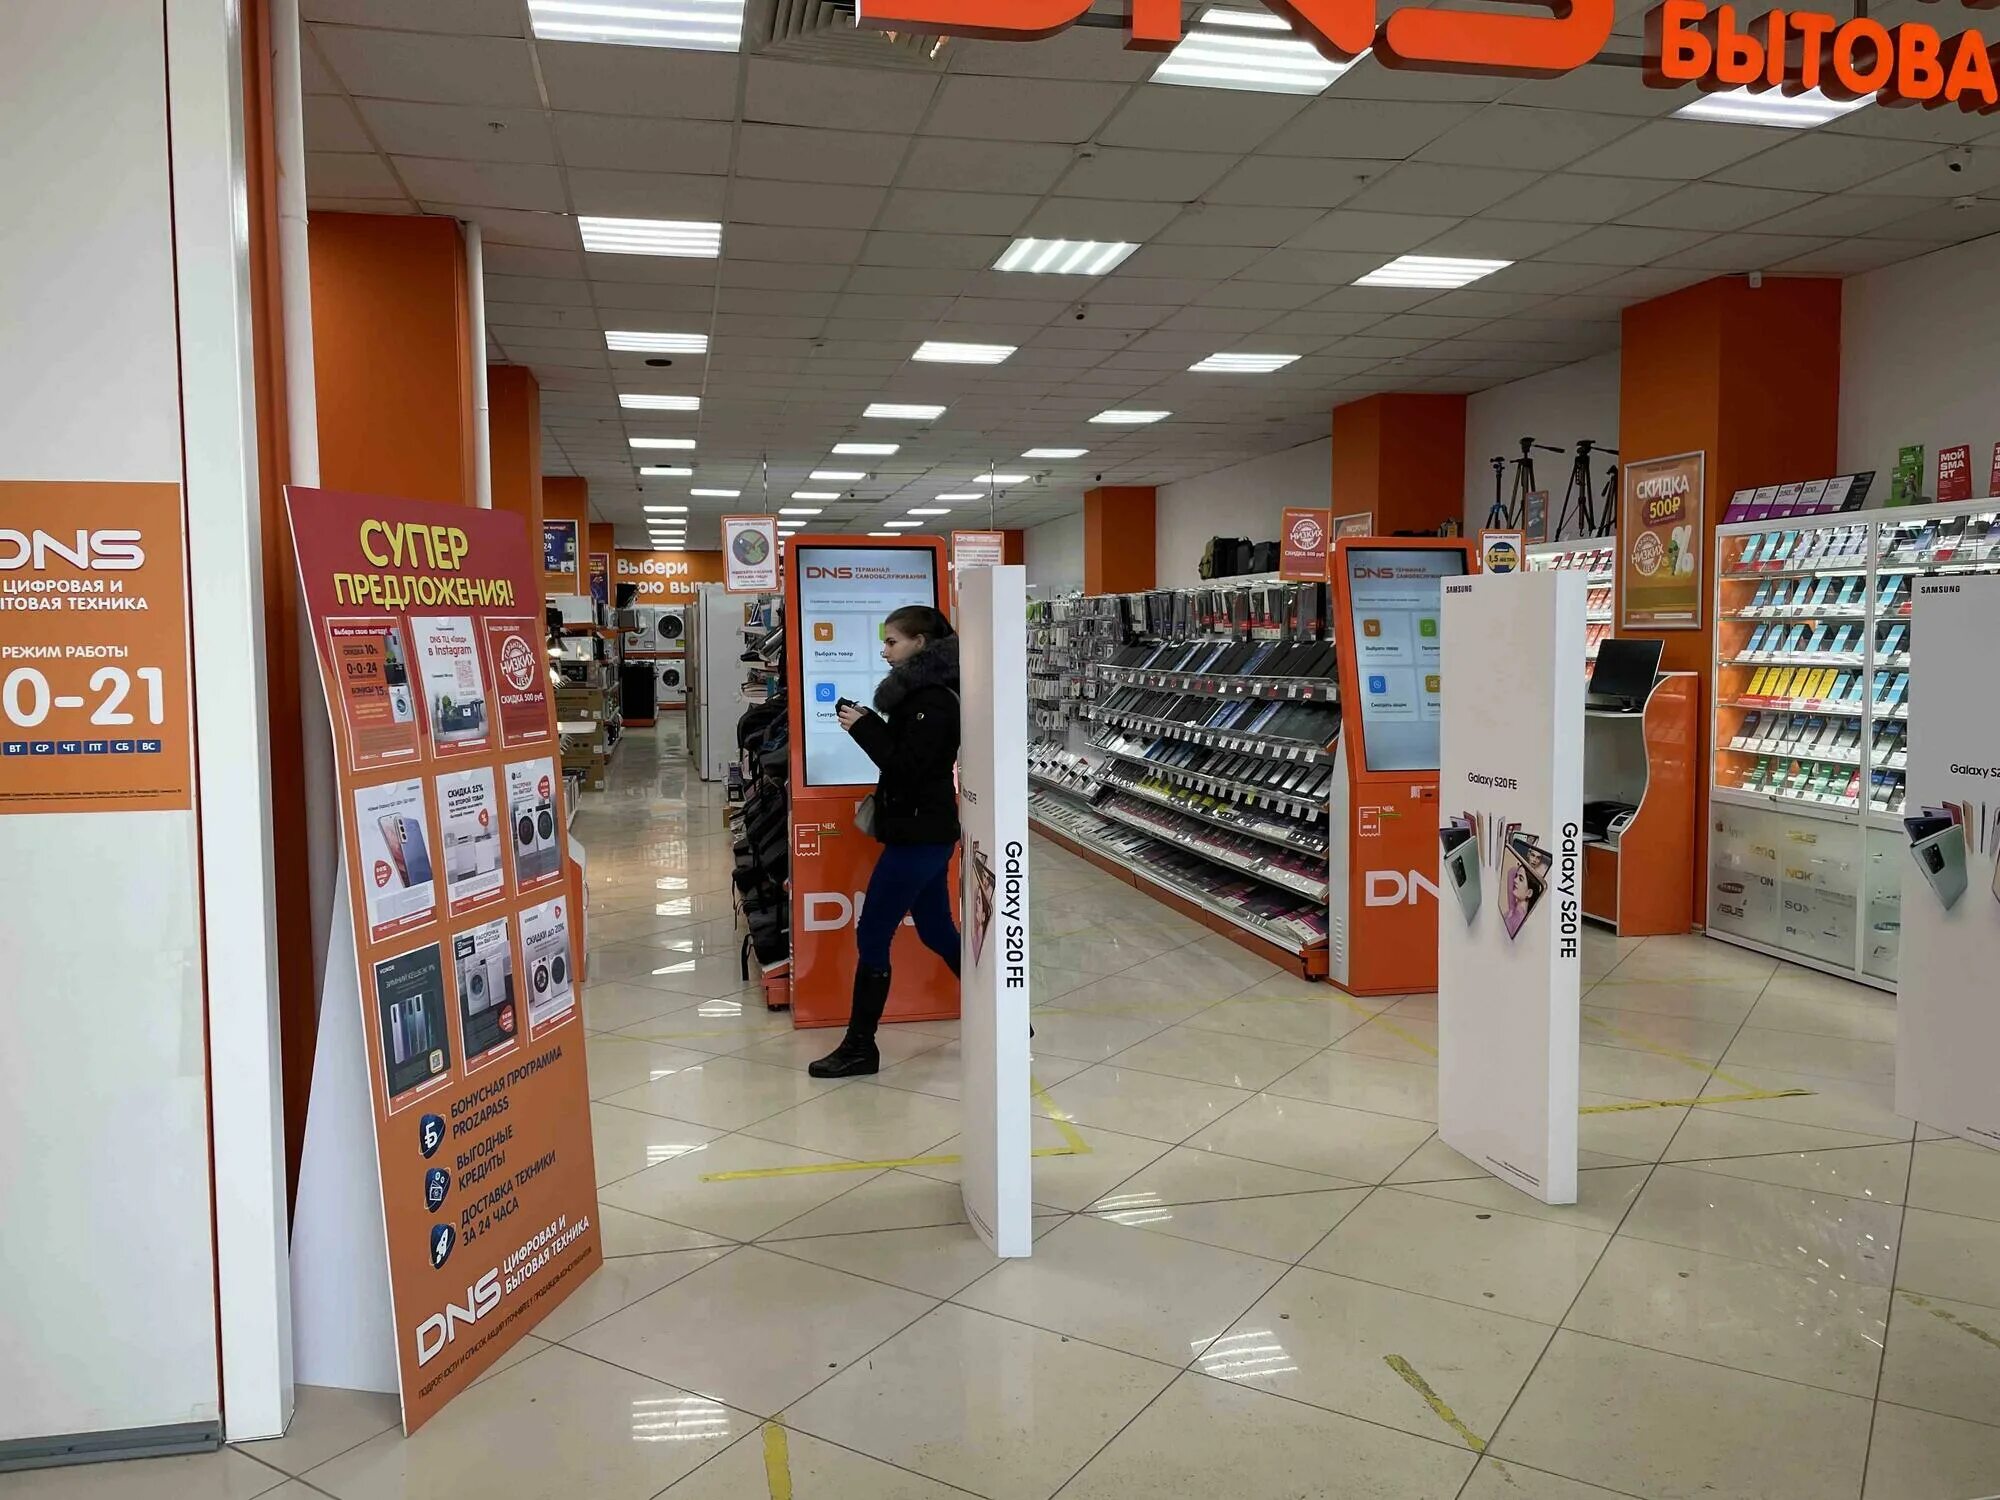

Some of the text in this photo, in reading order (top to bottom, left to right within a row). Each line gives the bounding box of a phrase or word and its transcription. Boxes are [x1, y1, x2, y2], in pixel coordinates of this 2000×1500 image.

[1660, 0, 1999, 105] БЫТОВА
[1940, 448, 1965, 462] МОЙ
[1636, 475, 1690, 499] СКИДКА
[1289, 529, 1323, 540] НИЗКИХ
[360, 519, 469, 570] СУПЕР
[1631, 543, 1665, 564] НИЗКИХ
[1489, 554, 1499, 563] 1,5
[617, 559, 688, 578] Выбери
[806, 566, 853, 579] DNS
[1353, 567, 1394, 579] DNS
[3, 580, 123, 594] ЦИФРОВАЯ И
[333, 573, 515, 611] ПРЕДЛОЖЕНИЯ!
[1446, 585, 1472, 594] SAMSUNG
[1920, 585, 1961, 594] SAMSUNG
[0, 597, 149, 611] ТОВАЯ ТЕХНИКА
[2, 647, 128, 658] РЕЖИМ РАБОТЫ
[435, 645, 472, 658] Instagram
[500, 652, 536, 676] НИЗКИХ
[501, 695, 524, 705] СКИДКА
[524, 692, 534, 702] 500
[9, 742, 156, 752] ВТ СР ЧТ ПТ СБ ВС
[1950, 763, 1989, 779] Galaxy
[1468, 772, 1518, 790] Galaxy S20 FE
[448, 787, 471, 798] СКИДКА
[822, 822, 836, 830] ЧЕК
[1365, 869, 1440, 906] DN
[1557, 822, 1579, 958] Galaxy S20 FE
[1001, 841, 1024, 988] Galaxy S20 FE
[1716, 903, 1745, 918] ASUS
[526, 930, 548, 946] СКИДКИ
[451, 1046, 563, 1118] БОНУСНАЯ ПРОГРАММА
[452, 1096, 510, 1139] PROZAPASS
[456, 1124, 513, 1170] ВЫГОДНЫЕ
[458, 1150, 506, 1192] КРЕДИТЫ
[461, 1150, 557, 1229] ДОСТАВКА ТЕХНИКИ
[463, 1197, 519, 1247] ЗА 24 ЧАСА
[503, 1214, 566, 1274] ЦИФРОВАЯ И
[505, 1215, 590, 1295] БЫТОВАЯ ТЕХНИКА
[416, 1267, 502, 1368] DNS
